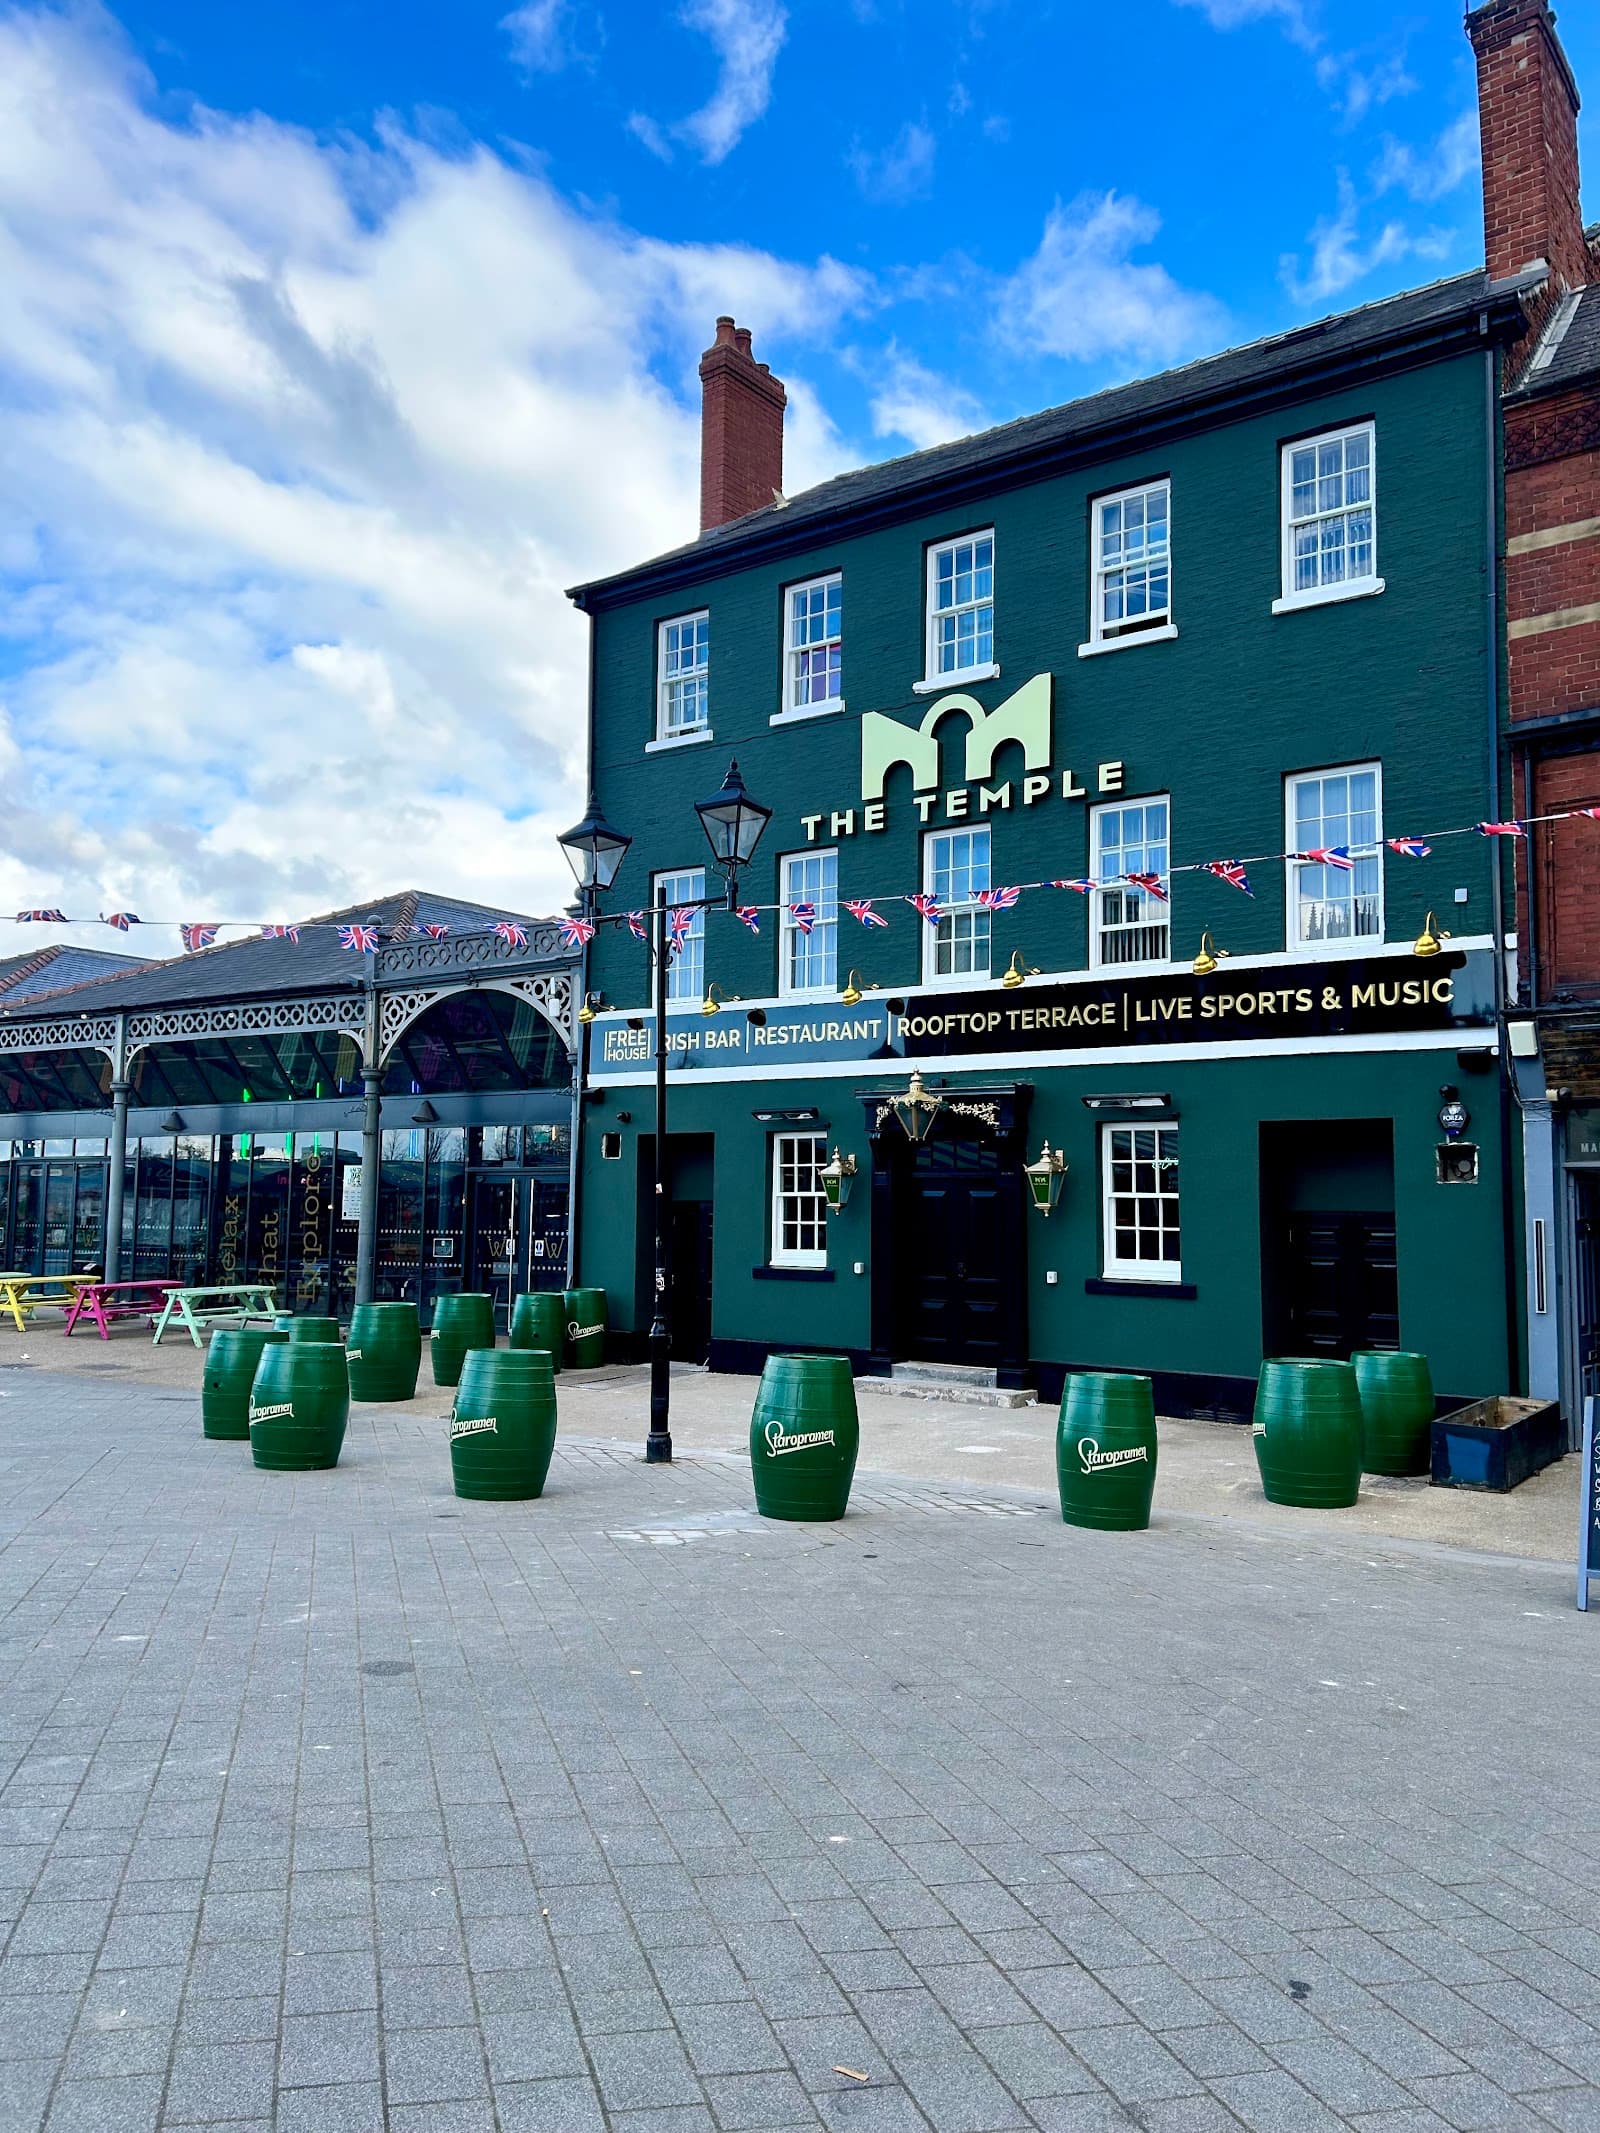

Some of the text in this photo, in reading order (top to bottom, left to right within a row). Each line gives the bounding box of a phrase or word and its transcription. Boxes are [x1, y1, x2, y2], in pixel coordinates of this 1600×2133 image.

[801, 761, 1122, 841] THE TEMPLE
[664, 978, 1455, 1051] RISH BAR RESTAURANT ROOFTOP TERRACE LIVE SPORTS & MUSIC
[607, 1047, 647, 1061] HOUSE
[608, 1028, 648, 1049] FREE
[1580, 1142, 1600, 1153] MA
[765, 1420, 836, 1458] Staropramen
[1077, 1437, 1148, 1475] Staropramen
